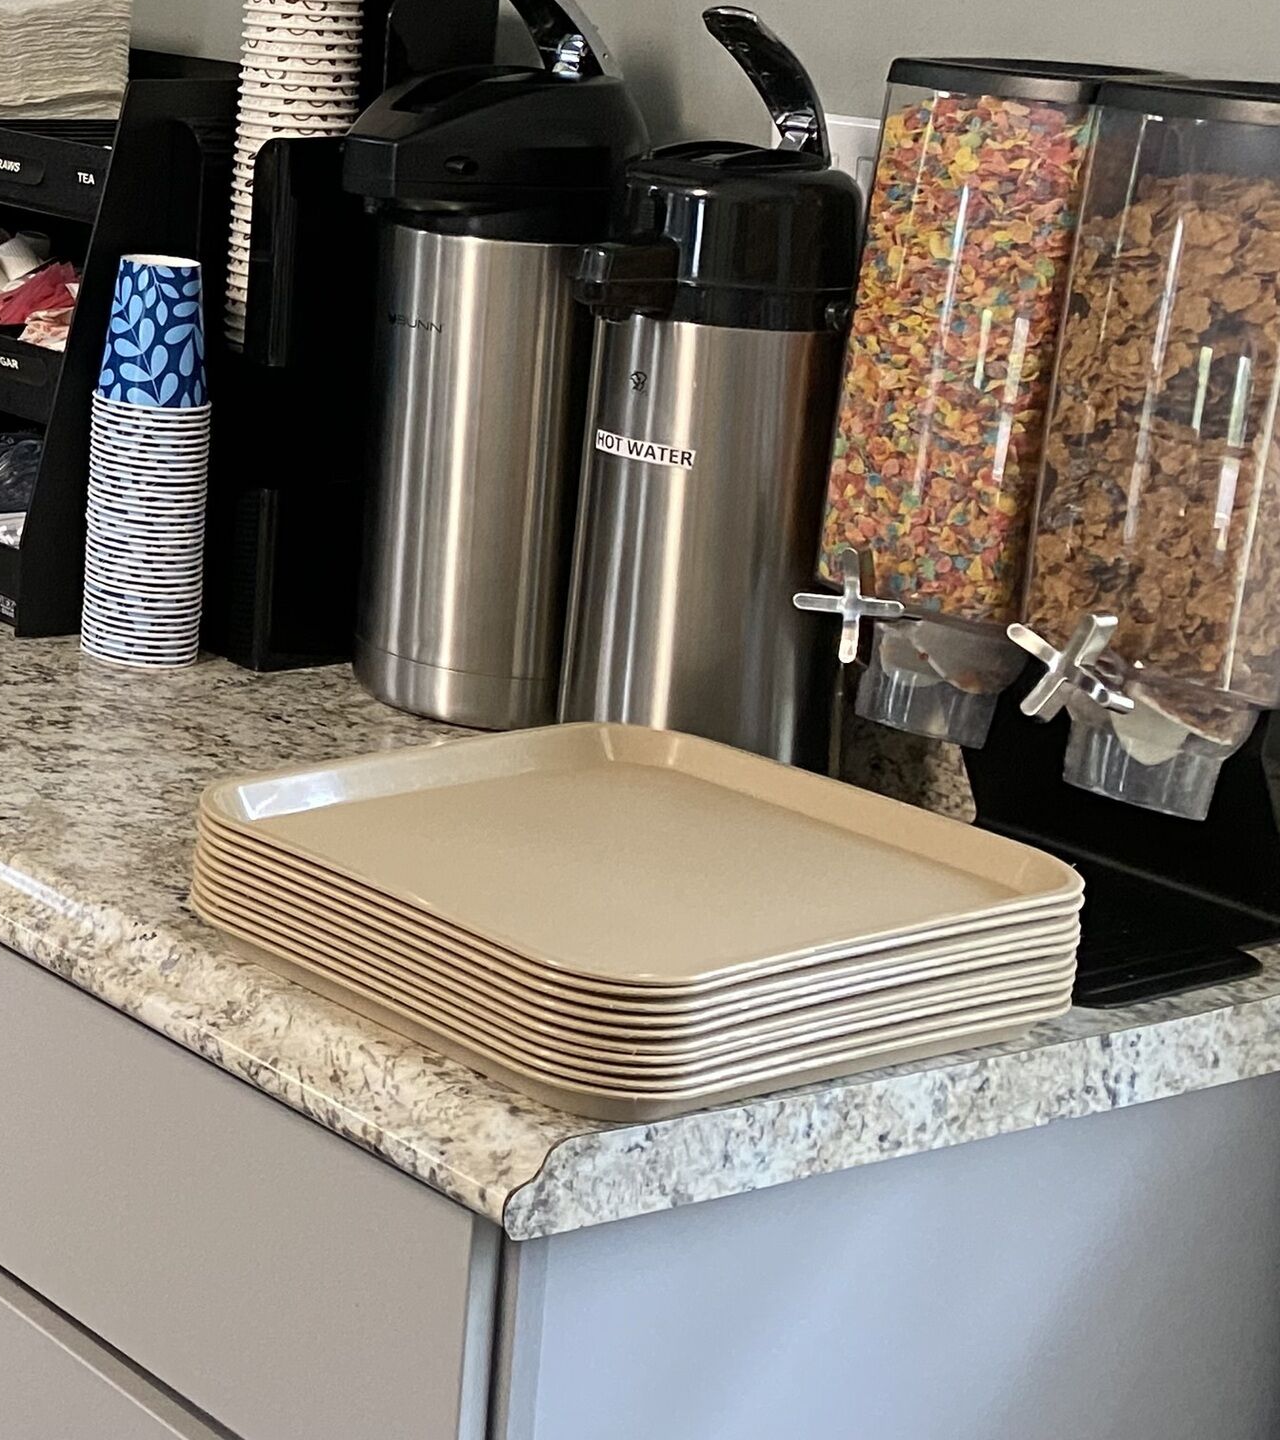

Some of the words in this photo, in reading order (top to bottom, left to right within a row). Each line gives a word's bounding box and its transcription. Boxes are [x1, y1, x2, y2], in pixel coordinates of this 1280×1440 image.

[77, 171, 95, 185] TEA
[397, 314, 442, 334] BUNN
[597, 432, 622, 452] HOT
[627, 440, 693, 466] WATER
